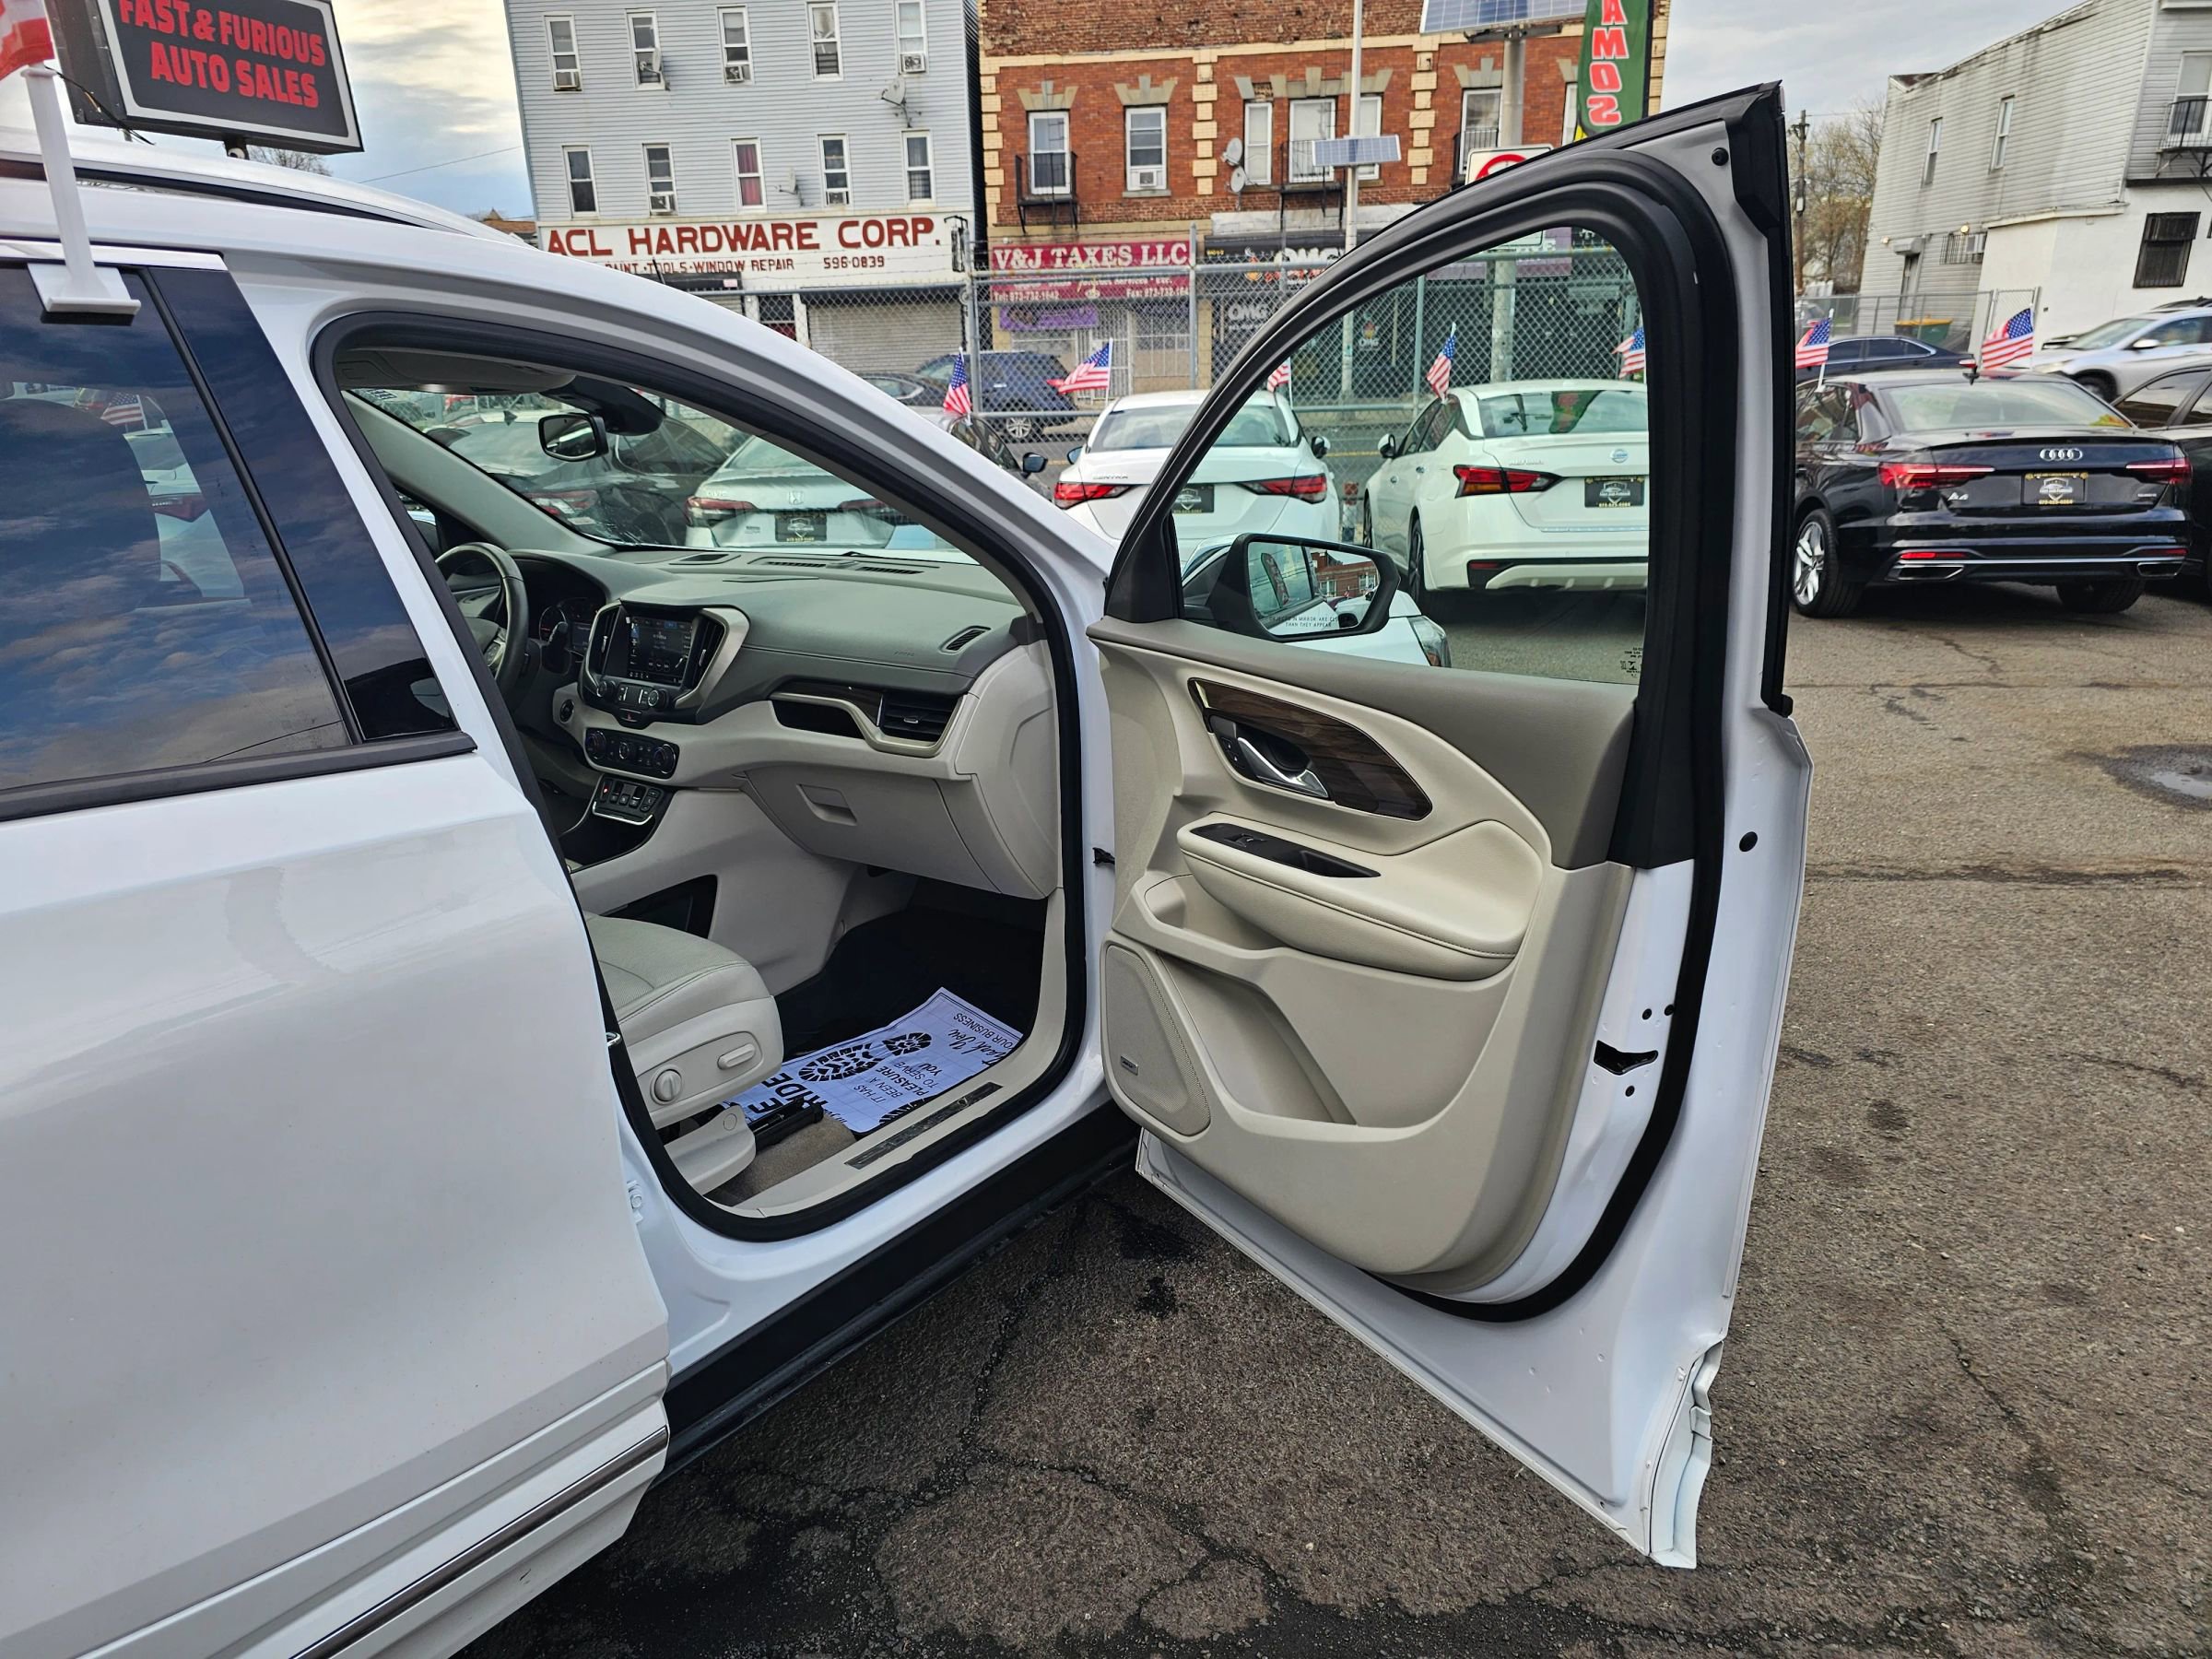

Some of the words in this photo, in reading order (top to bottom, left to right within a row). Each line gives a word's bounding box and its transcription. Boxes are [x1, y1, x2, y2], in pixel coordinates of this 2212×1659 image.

[119, 0, 190, 37] FAST
[192, 9, 216, 41] &
[218, 11, 325, 66] FURIOUS
[151, 41, 230, 93] AUTO
[236, 59, 319, 108] SALES
[547, 229, 613, 256] ACL
[628, 221, 820, 255] HARDWARE
[838, 217, 941, 249] CORP.
[751, 258, 794, 271] REPAIR
[823, 255, 885, 269] 596-0839
[994, 248, 1042, 269] V&J
[1051, 244, 1133, 267] TAXES
[1140, 242, 1187, 265] LLC
[953, 1013, 995, 1039] BUSINESS
[948, 1029, 977, 1050] You
[876, 1065, 929, 1096] PLEASURE
[893, 1061, 925, 1080] SERVE
[919, 1063, 943, 1077] YOU
[853, 1085, 877, 1098] HAS
[875, 1082, 903, 1099] BEEN
[923, 1078, 940, 1088] TO
